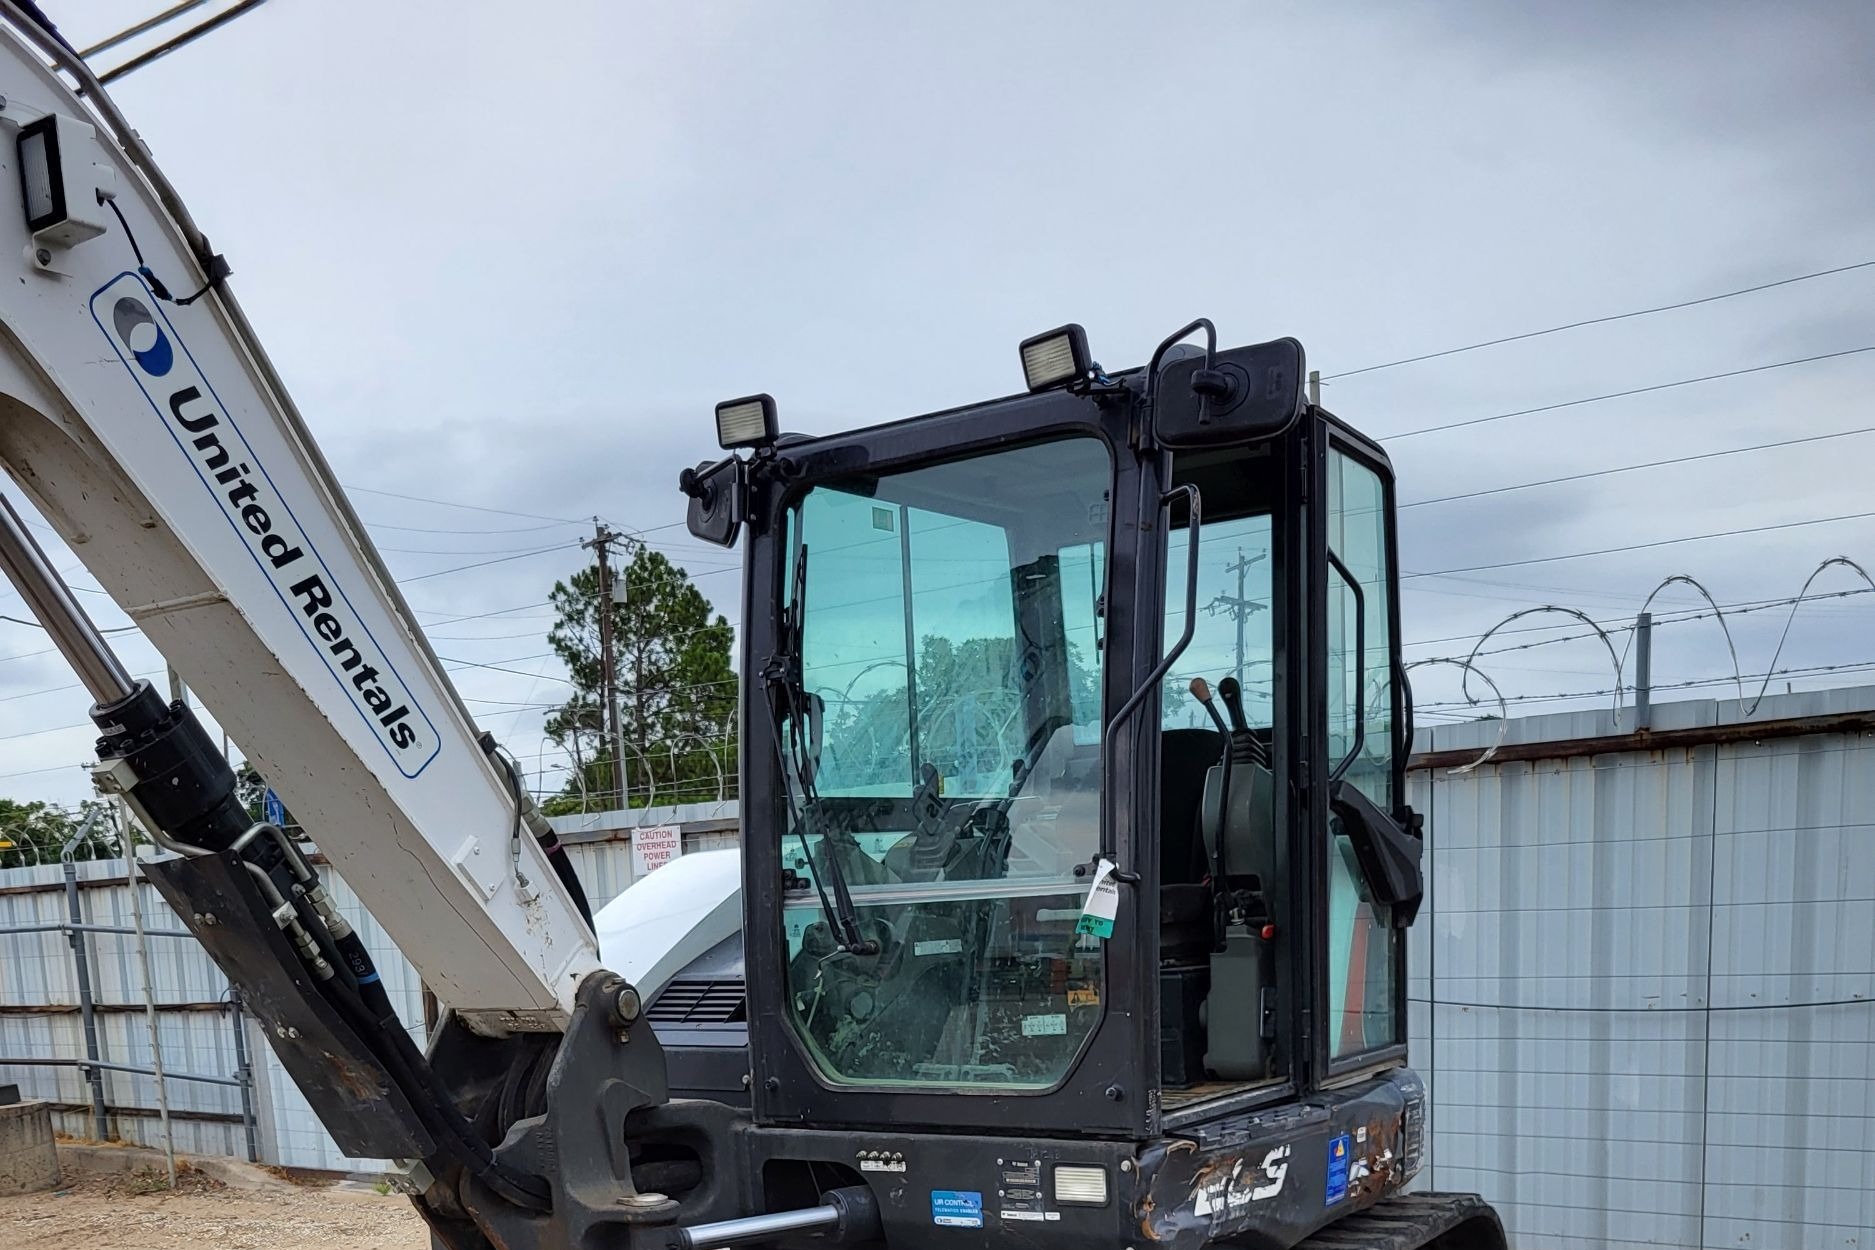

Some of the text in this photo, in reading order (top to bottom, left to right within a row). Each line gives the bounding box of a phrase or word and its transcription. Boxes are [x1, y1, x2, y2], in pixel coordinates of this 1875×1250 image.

[168, 384, 417, 751] United Rentals
[639, 830, 673, 840] CAUTION
[636, 840, 677, 851] OVERHEAD
[643, 851, 671, 861] POWER
